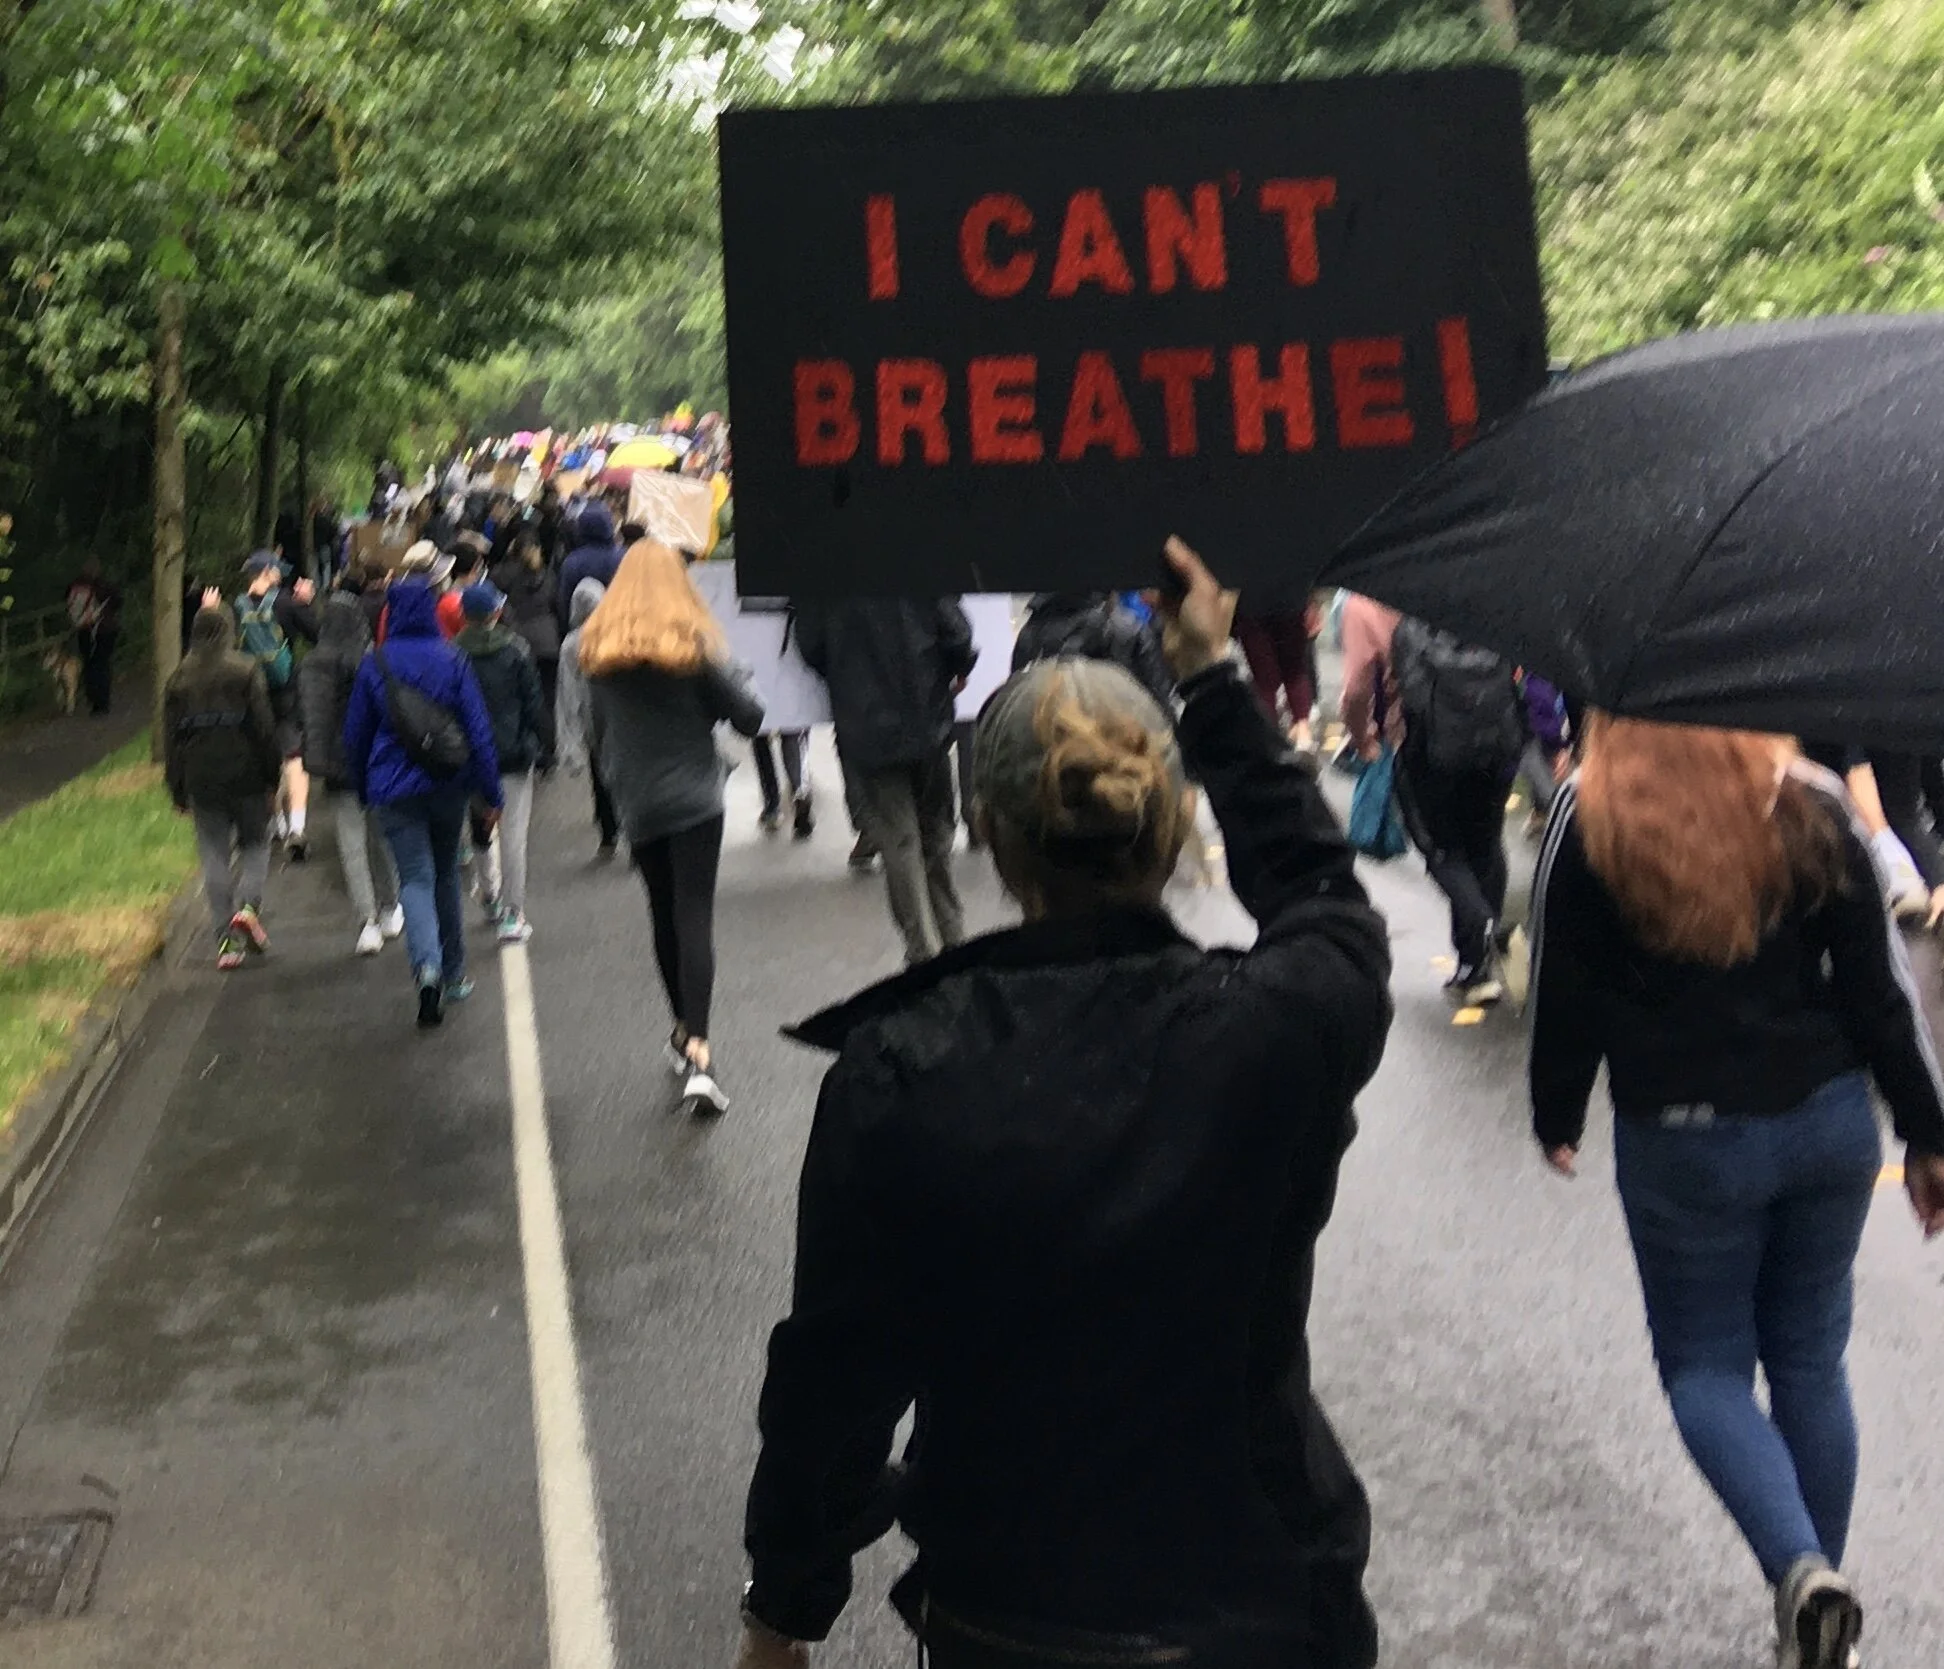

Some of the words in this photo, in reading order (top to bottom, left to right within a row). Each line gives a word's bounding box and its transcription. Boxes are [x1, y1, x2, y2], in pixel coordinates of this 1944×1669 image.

[866, 193, 900, 300] I
[958, 170, 1337, 299] CAN'T
[793, 316, 1479, 467] BREATHE!
